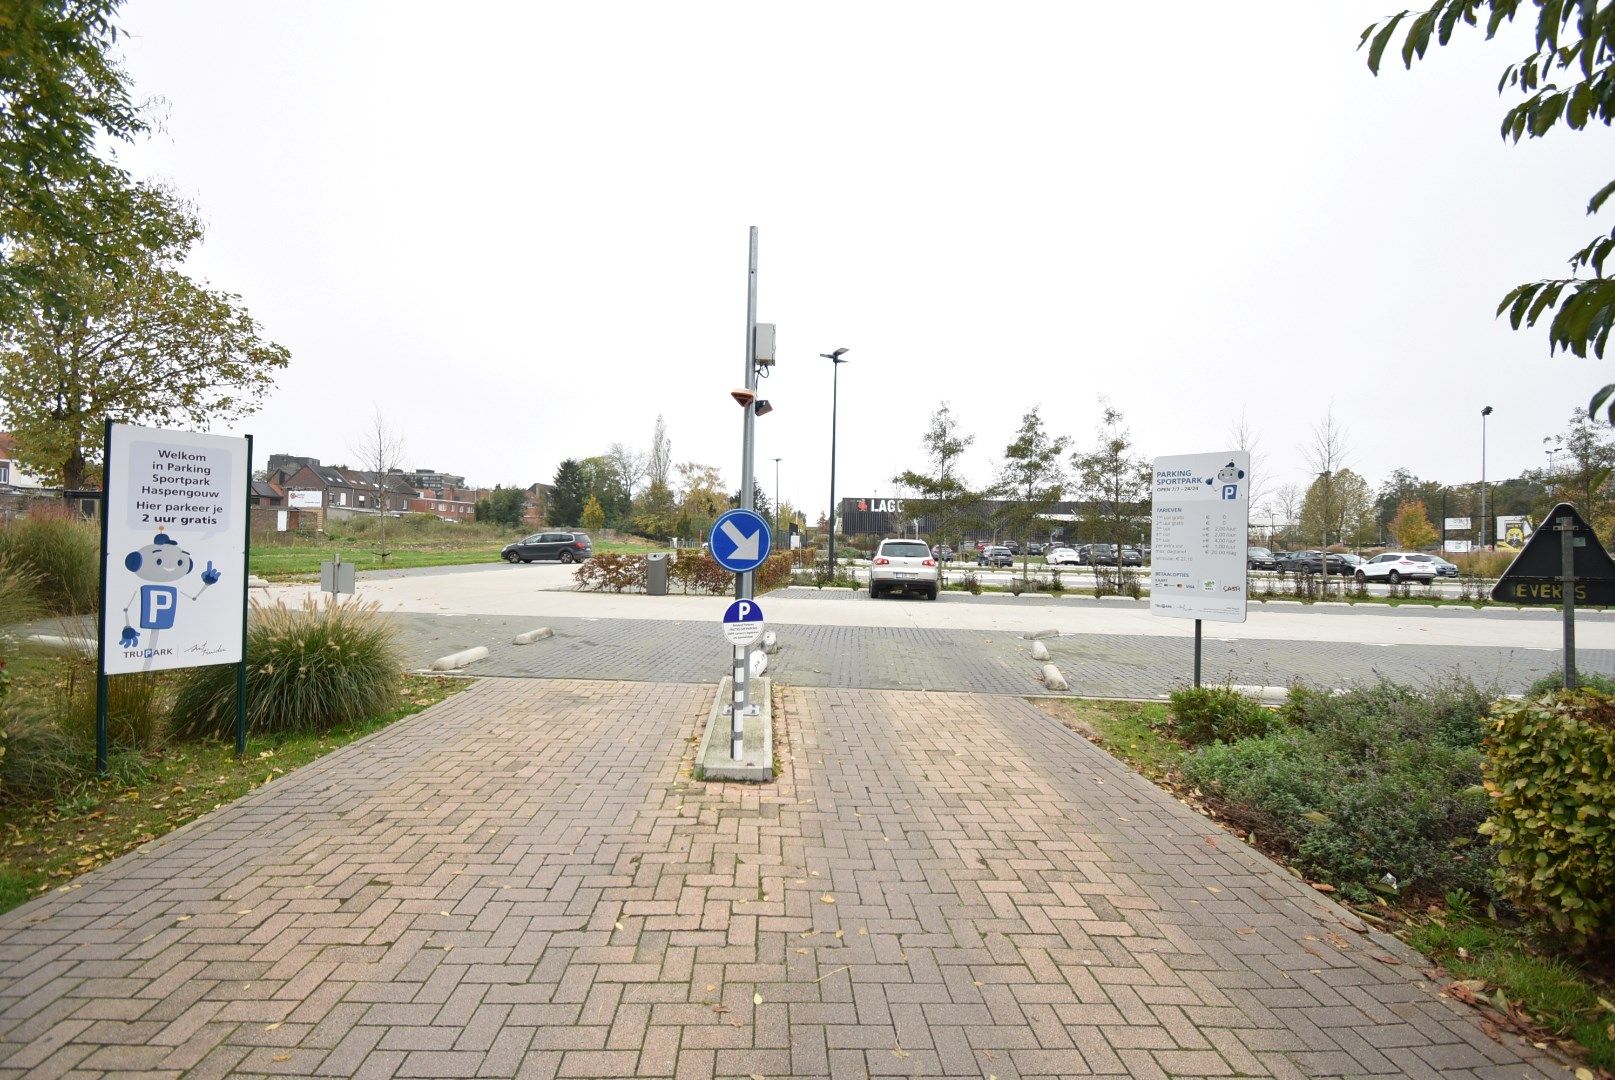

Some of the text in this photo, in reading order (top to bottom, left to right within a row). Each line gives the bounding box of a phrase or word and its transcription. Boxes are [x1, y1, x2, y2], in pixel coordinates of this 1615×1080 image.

[158, 450, 206, 461] Welkom
[152, 461, 211, 476] in Parking
[1156, 470, 1192, 478] PARKING
[152, 474, 210, 486] Sportpark
[1156, 477, 1202, 485] SPORTPARK
[141, 486, 219, 498] Haspengouw
[1224, 486, 1234, 500] P
[136, 501, 223, 515] Hier parkeer je
[141, 514, 150, 523] 2
[180, 516, 217, 526] gratis
[1516, 583, 1586, 600] EVERS
[149, 590, 173, 623] P
[738, 602, 751, 621] P
[123, 648, 173, 659] TRUPARK
